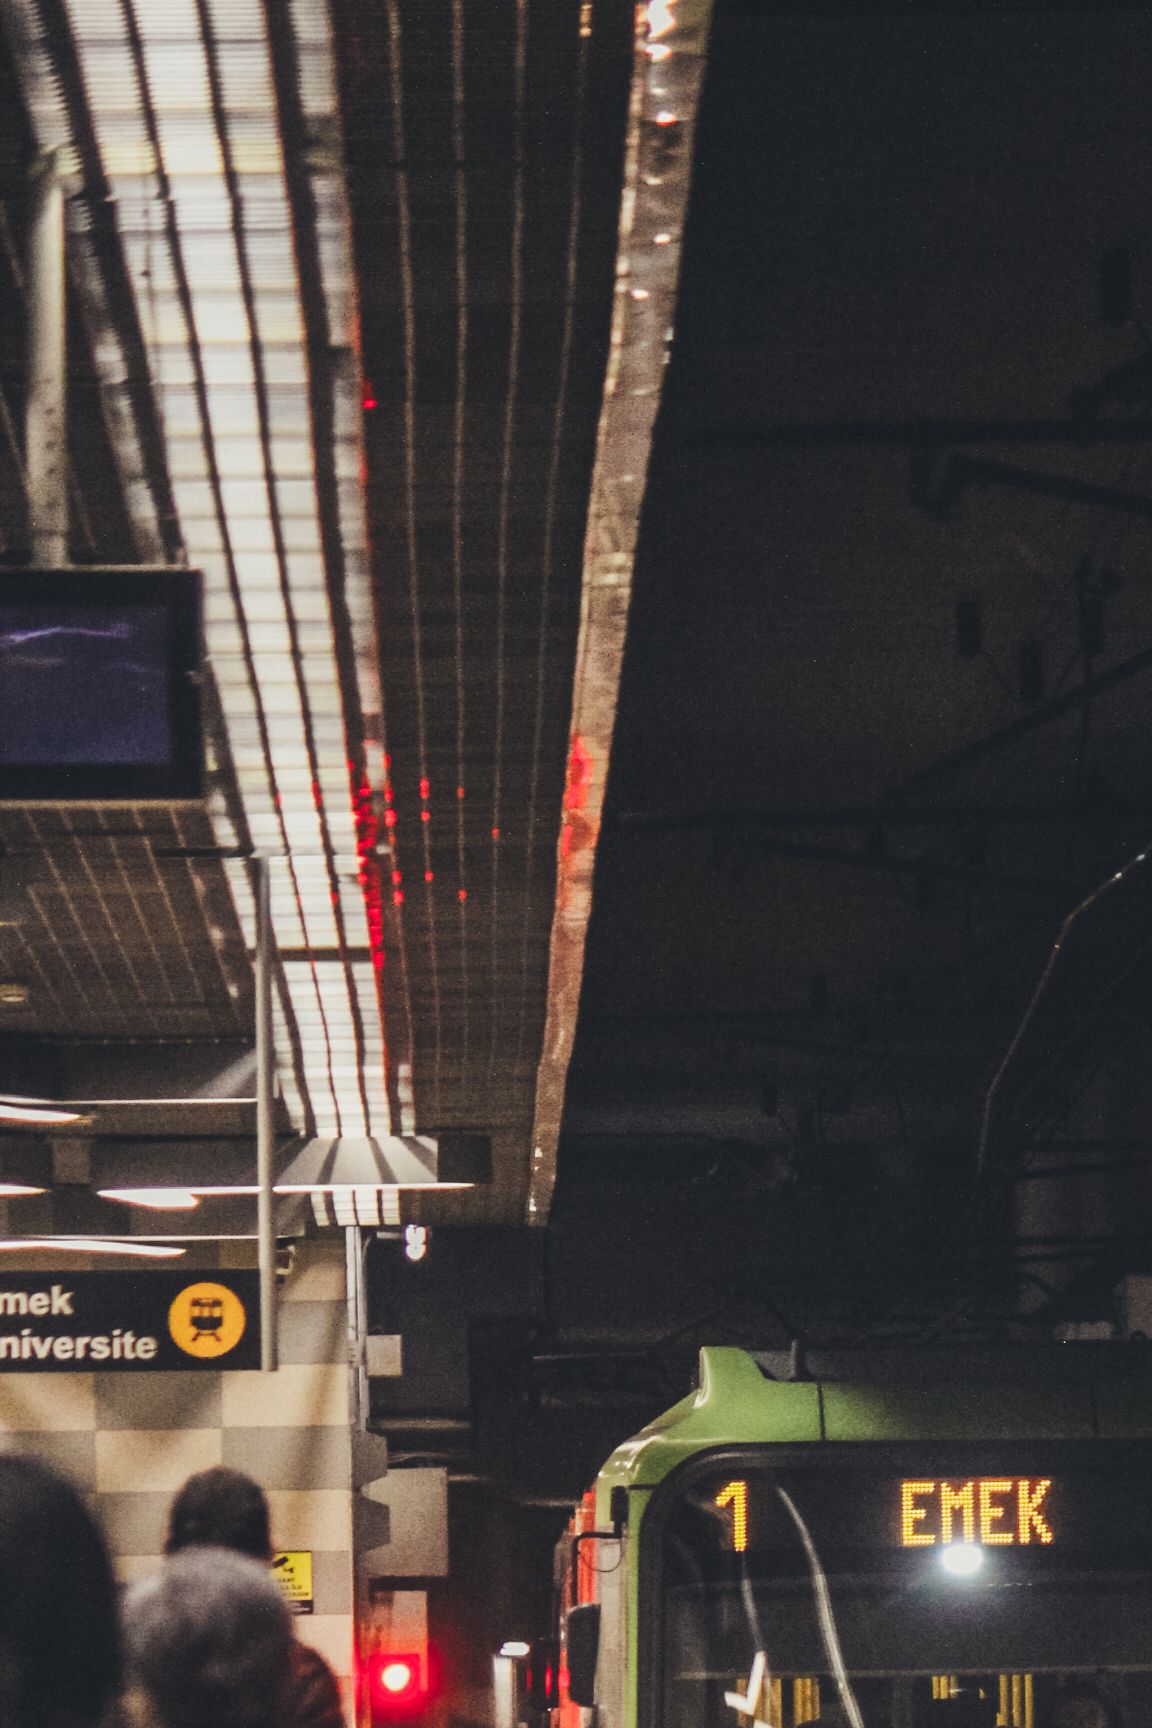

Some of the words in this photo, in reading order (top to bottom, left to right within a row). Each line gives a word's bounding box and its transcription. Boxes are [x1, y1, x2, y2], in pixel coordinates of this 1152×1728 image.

[0, 1328, 158, 1360] niversite
[715, 1480, 747, 1552] 1
[901, 1478, 1053, 1546] EMEK
